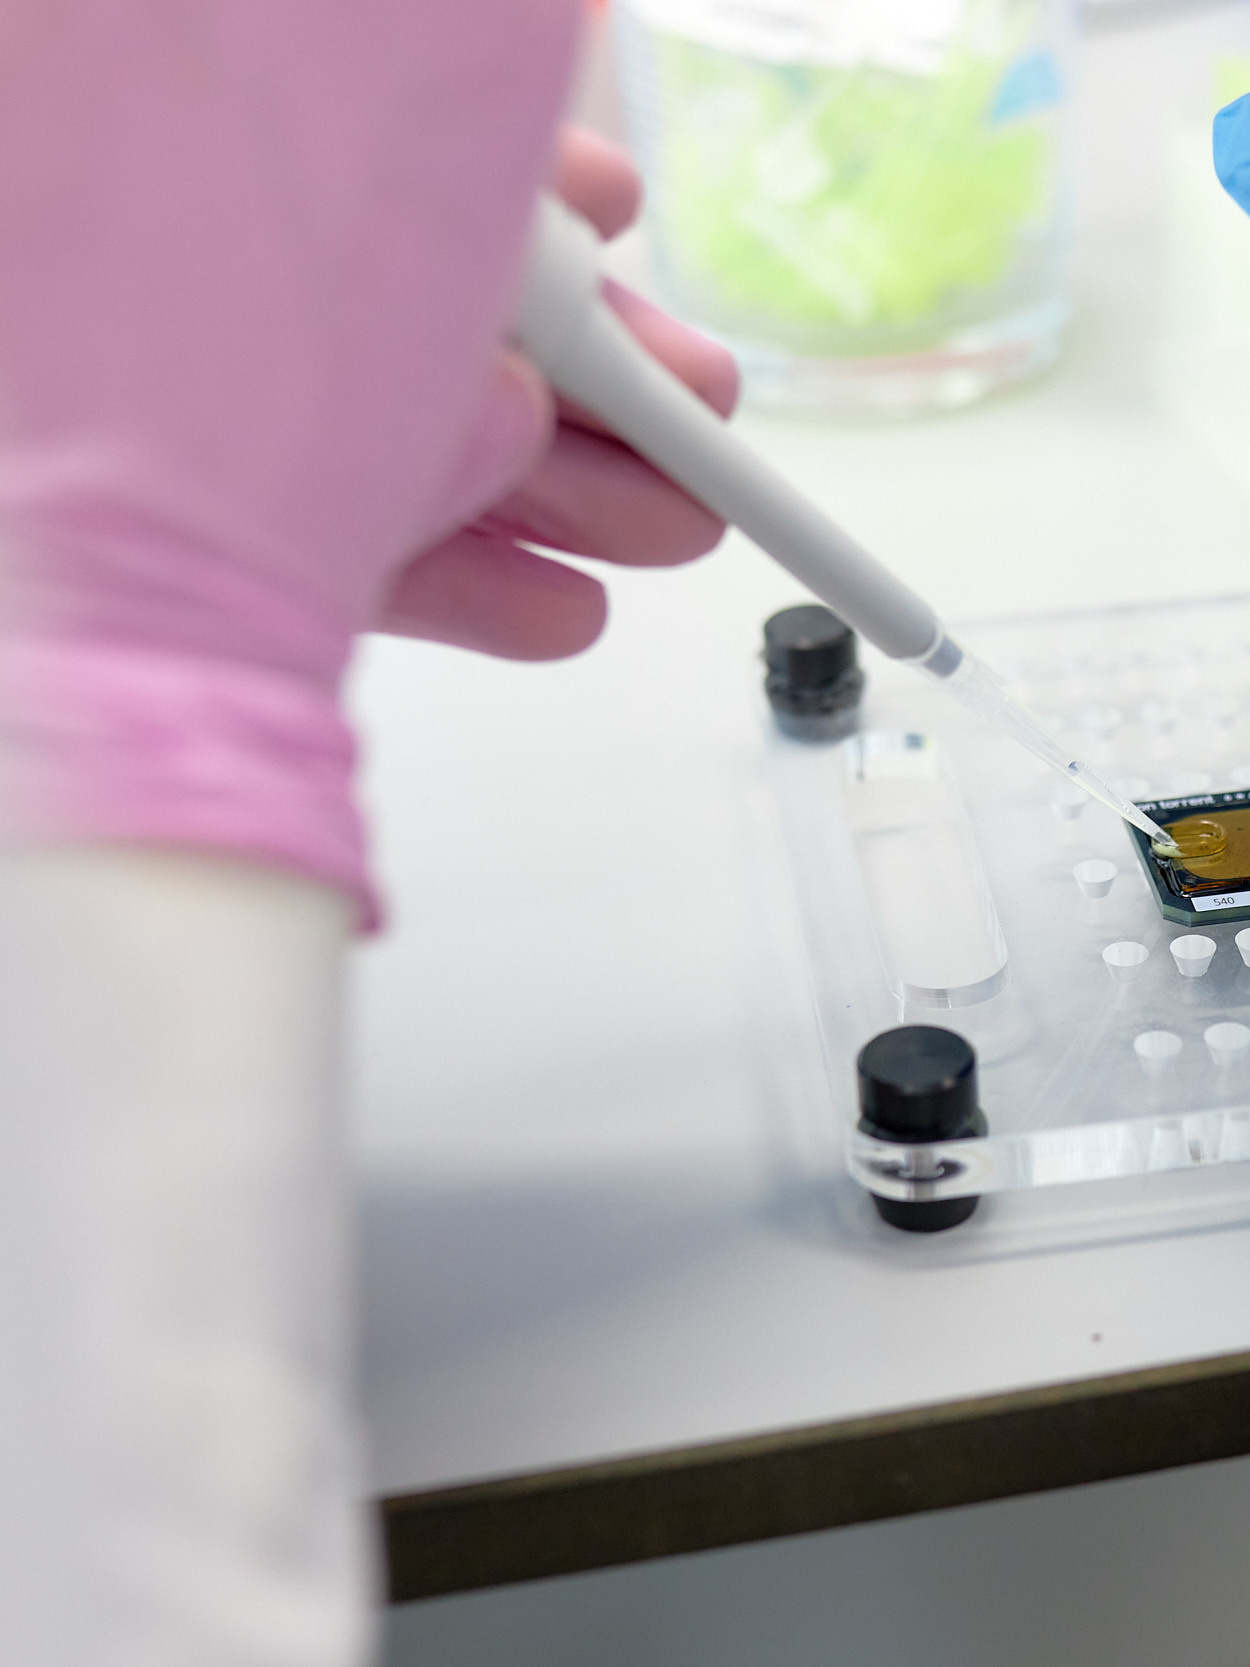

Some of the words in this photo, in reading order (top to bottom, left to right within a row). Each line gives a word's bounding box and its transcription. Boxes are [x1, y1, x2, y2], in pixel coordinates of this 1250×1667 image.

[1135, 802, 1157, 812] on
[1159, 795, 1214, 810] torrent
[1213, 896, 1235, 907] 540
